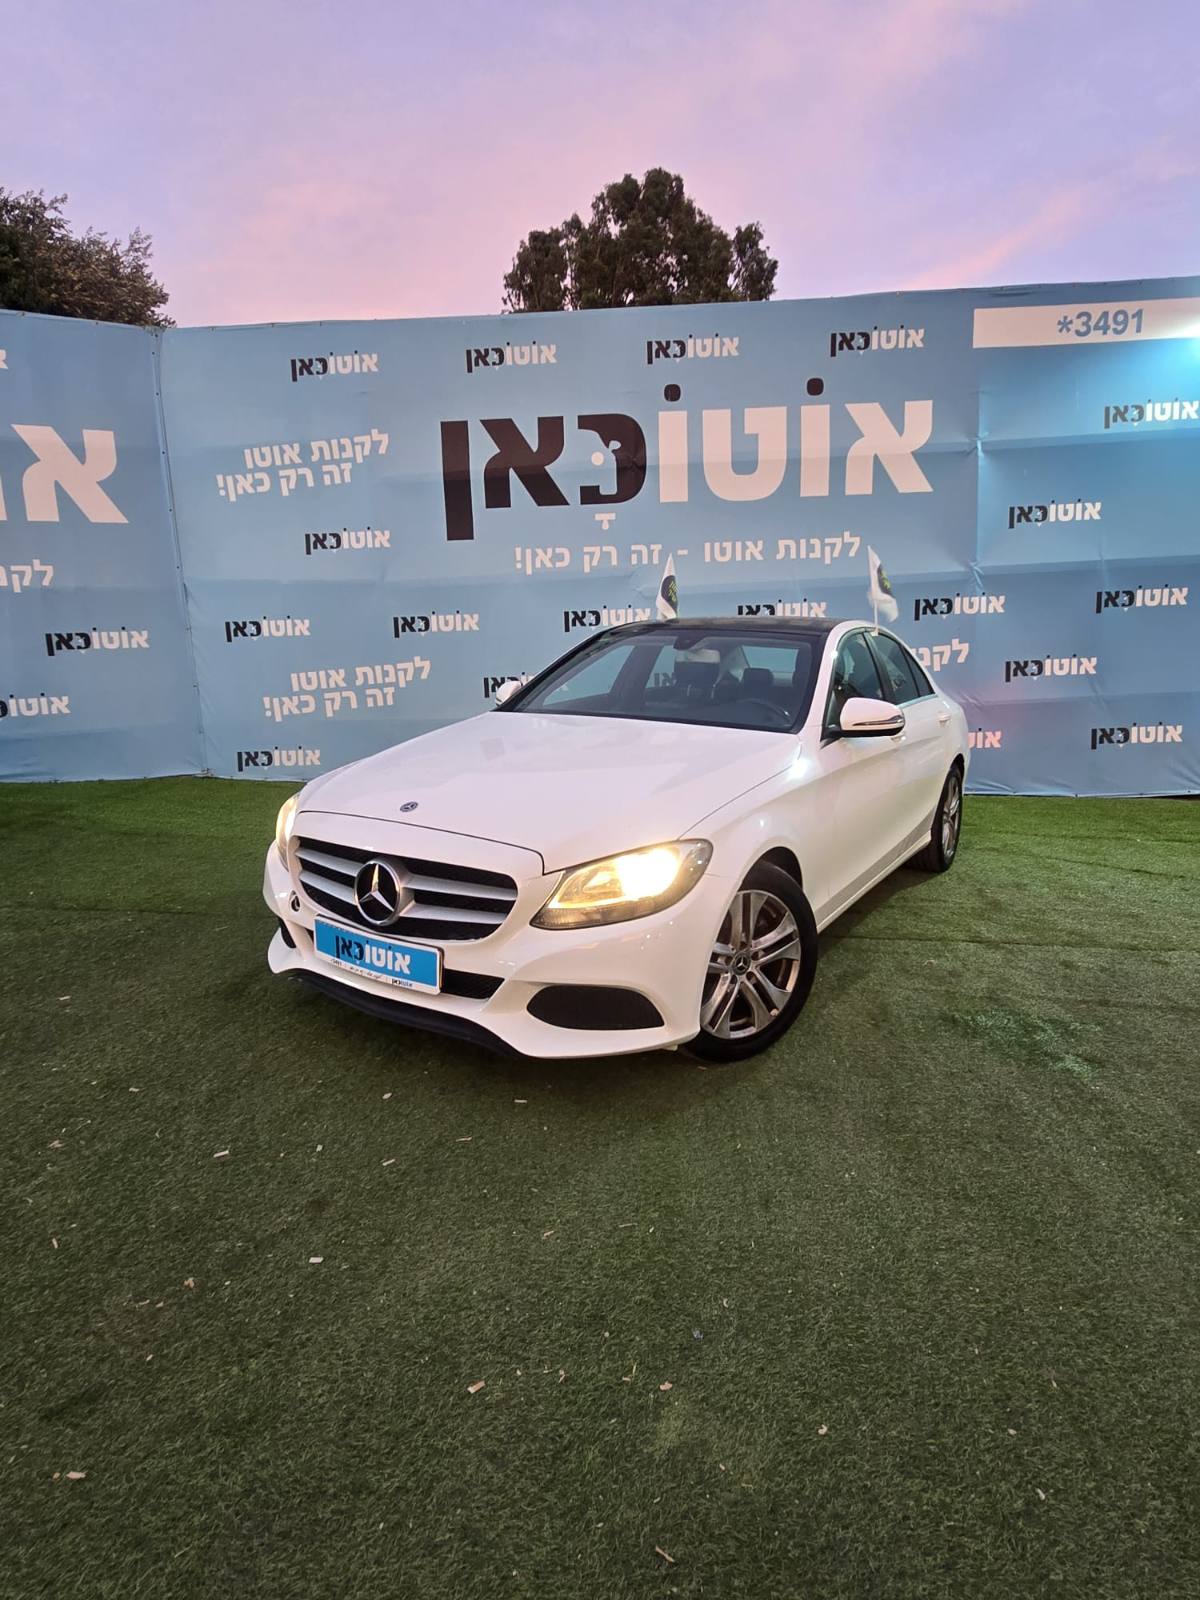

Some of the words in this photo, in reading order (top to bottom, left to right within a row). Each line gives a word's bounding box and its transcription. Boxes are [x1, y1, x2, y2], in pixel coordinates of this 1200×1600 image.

[244, 442, 302, 470] אוטו
[311, 428, 389, 463] לקנות
[216, 471, 271, 502] כאן!
[279, 467, 315, 497] רק
[322, 462, 353, 486] זה
[514, 546, 571, 576] כאן!
[583, 545, 618, 573] רק
[631, 543, 662, 565] זה
[704, 539, 764, 562] אוטו
[776, 531, 861, 565] לקנות
[290, 669, 347, 692] אוטו
[355, 655, 431, 688] לקנות
[263, 694, 316, 722] כאן!
[323, 690, 358, 718] רק
[365, 686, 395, 708] זה
